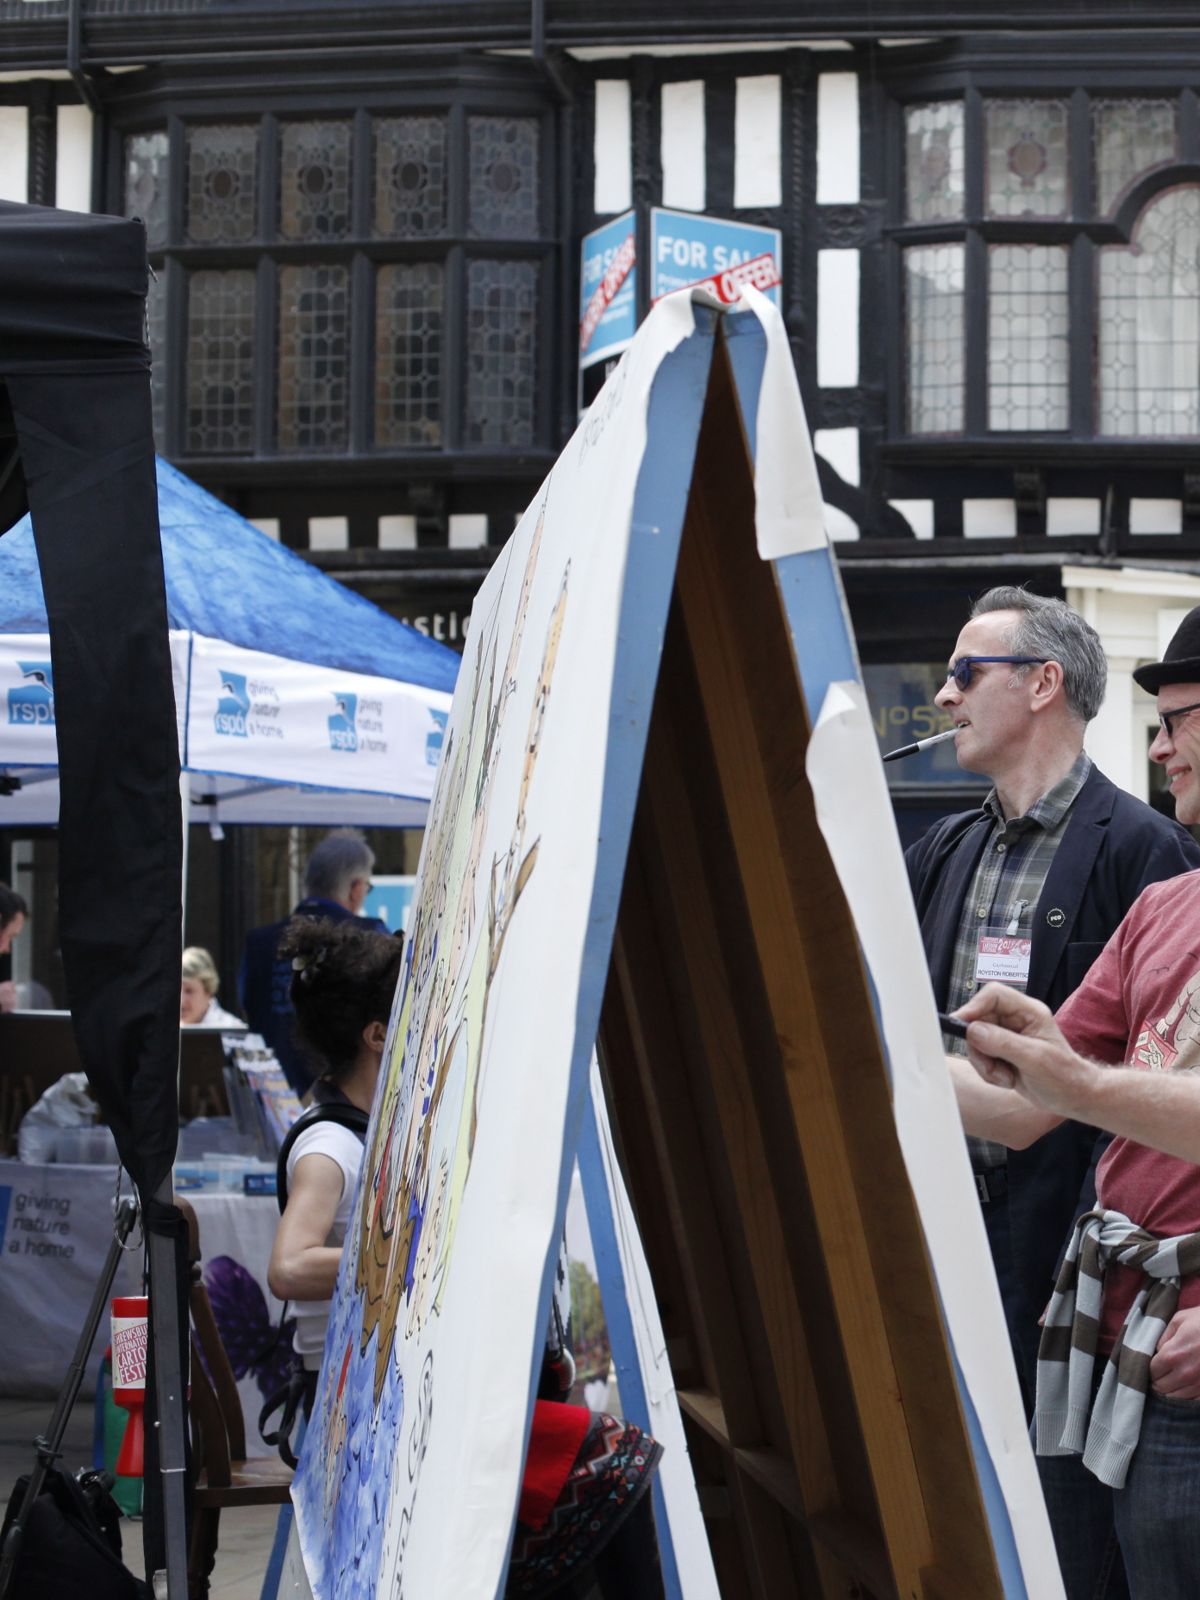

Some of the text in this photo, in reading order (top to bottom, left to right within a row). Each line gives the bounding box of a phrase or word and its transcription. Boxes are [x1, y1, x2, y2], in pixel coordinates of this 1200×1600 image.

[657, 235, 761, 272] FOR SAL
[215, 710, 247, 735] rspb
[331, 726, 357, 751] rspb
[15, 1190, 71, 1217] giving
[12, 1216, 71, 1236] nature
[9, 1237, 75, 1259] a home
[119, 1361, 147, 1385] FESTI
